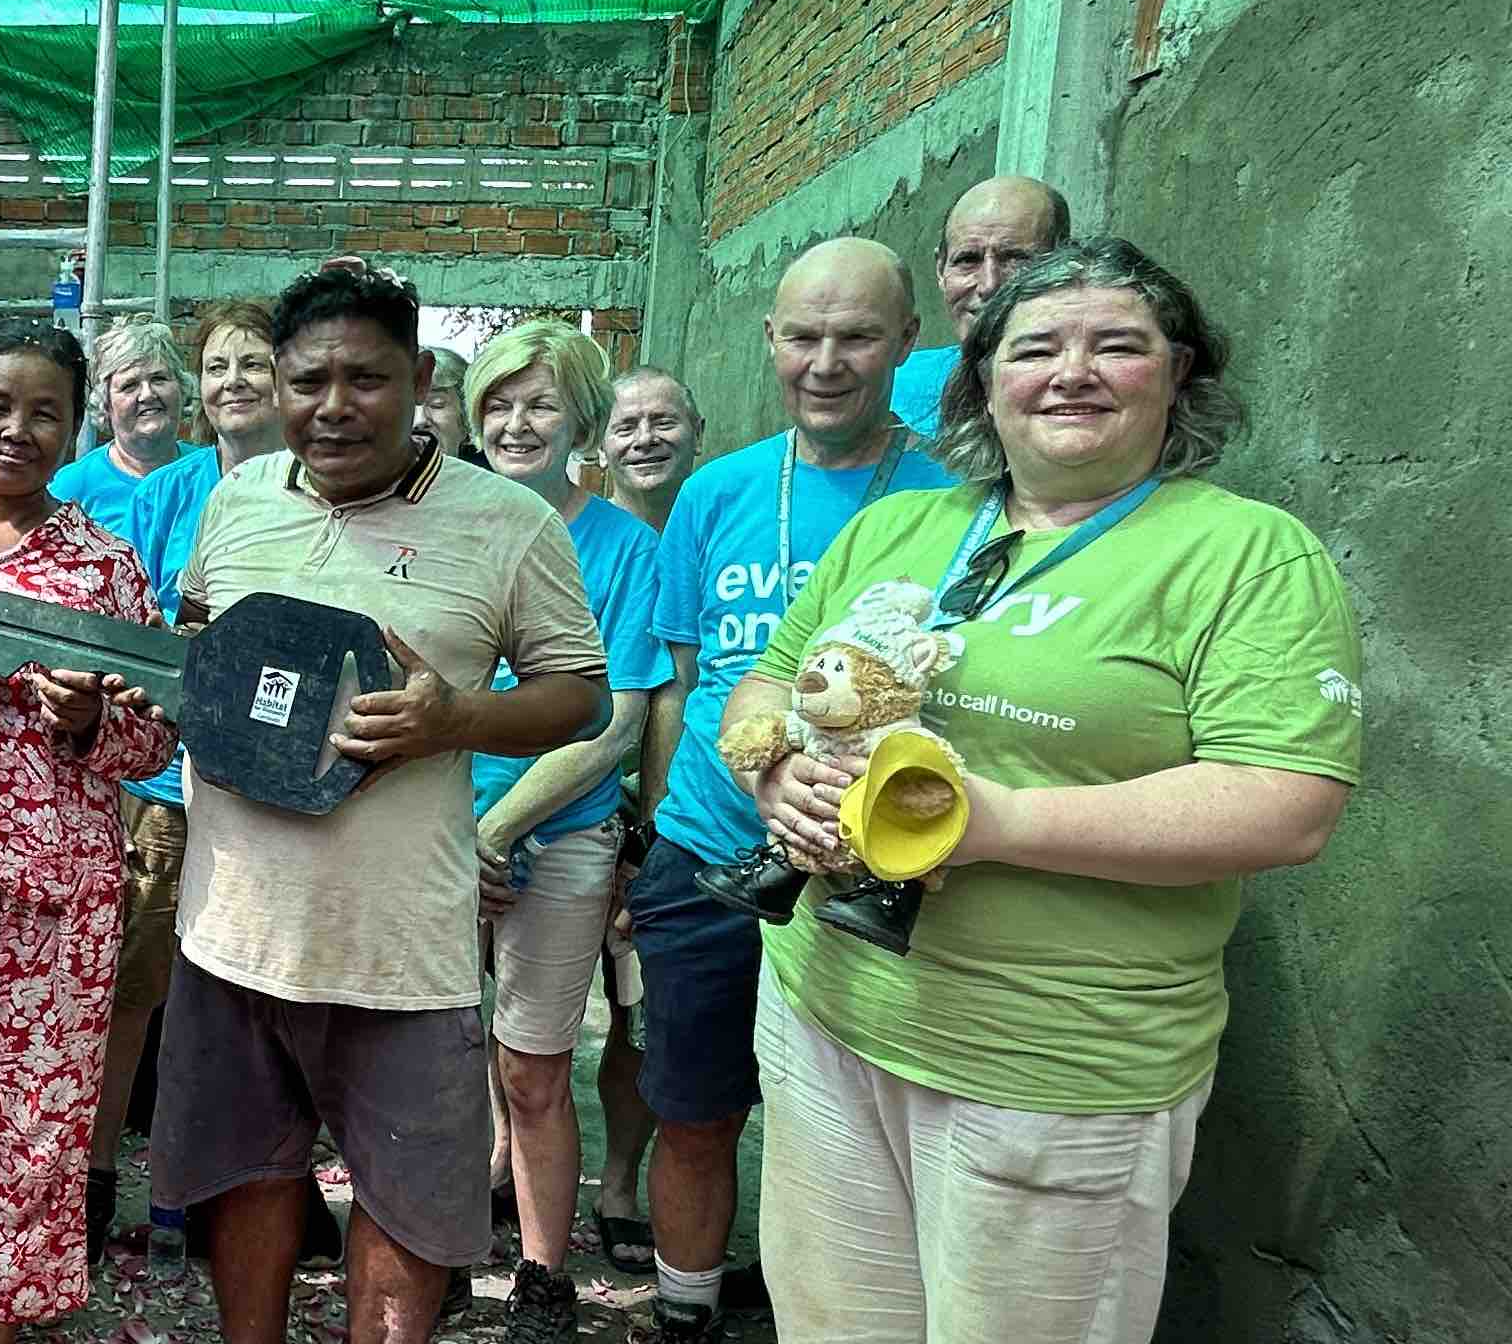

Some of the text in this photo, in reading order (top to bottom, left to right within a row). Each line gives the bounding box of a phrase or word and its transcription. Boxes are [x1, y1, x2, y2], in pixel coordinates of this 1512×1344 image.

[715, 560, 816, 602] eve
[718, 611, 780, 651] on
[937, 689, 957, 707] to
[959, 693, 999, 715] call
[999, 698, 1077, 733] home
